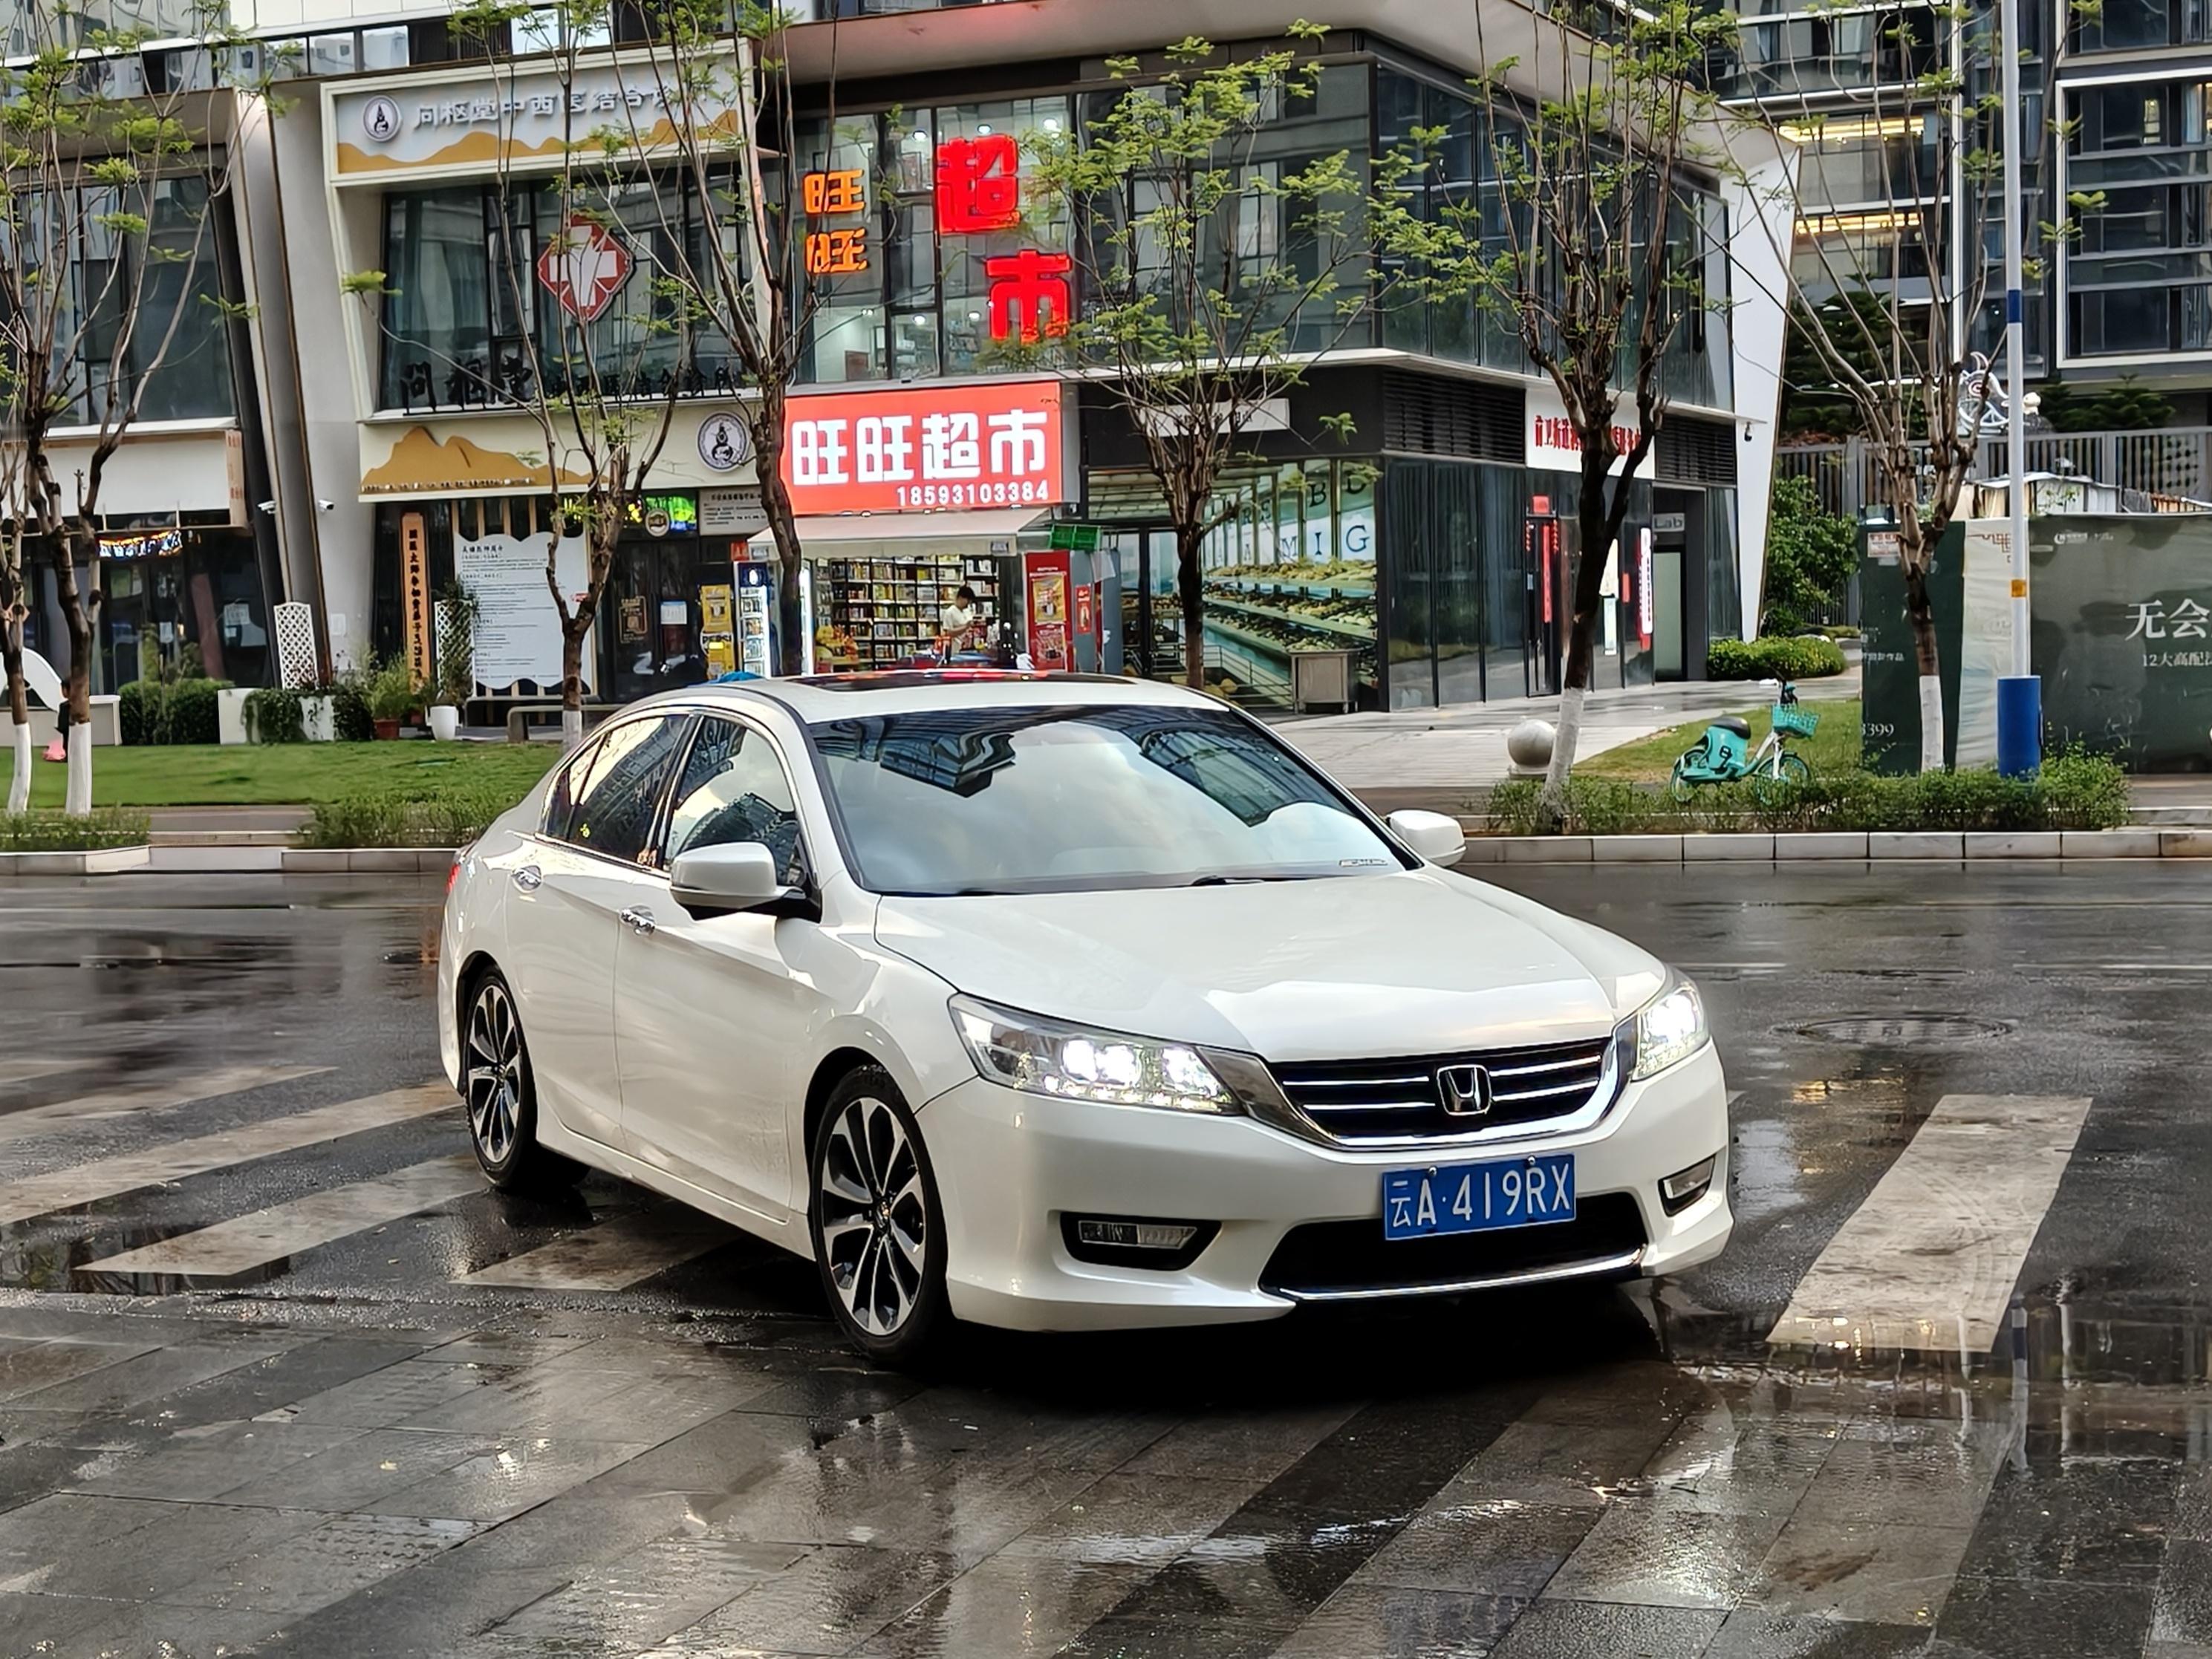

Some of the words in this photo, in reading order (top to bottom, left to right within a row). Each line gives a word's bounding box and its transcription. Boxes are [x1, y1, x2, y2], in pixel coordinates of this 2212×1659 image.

[414, 86, 707, 128] 问枢堂中西医结合
[802, 168, 868, 274] 旺旺
[791, 407, 1048, 486] 旺旺超市
[897, 480, 1050, 506] 18593103384
[1653, 518, 1683, 529] Lab
[2124, 597, 2212, 641] 无会
